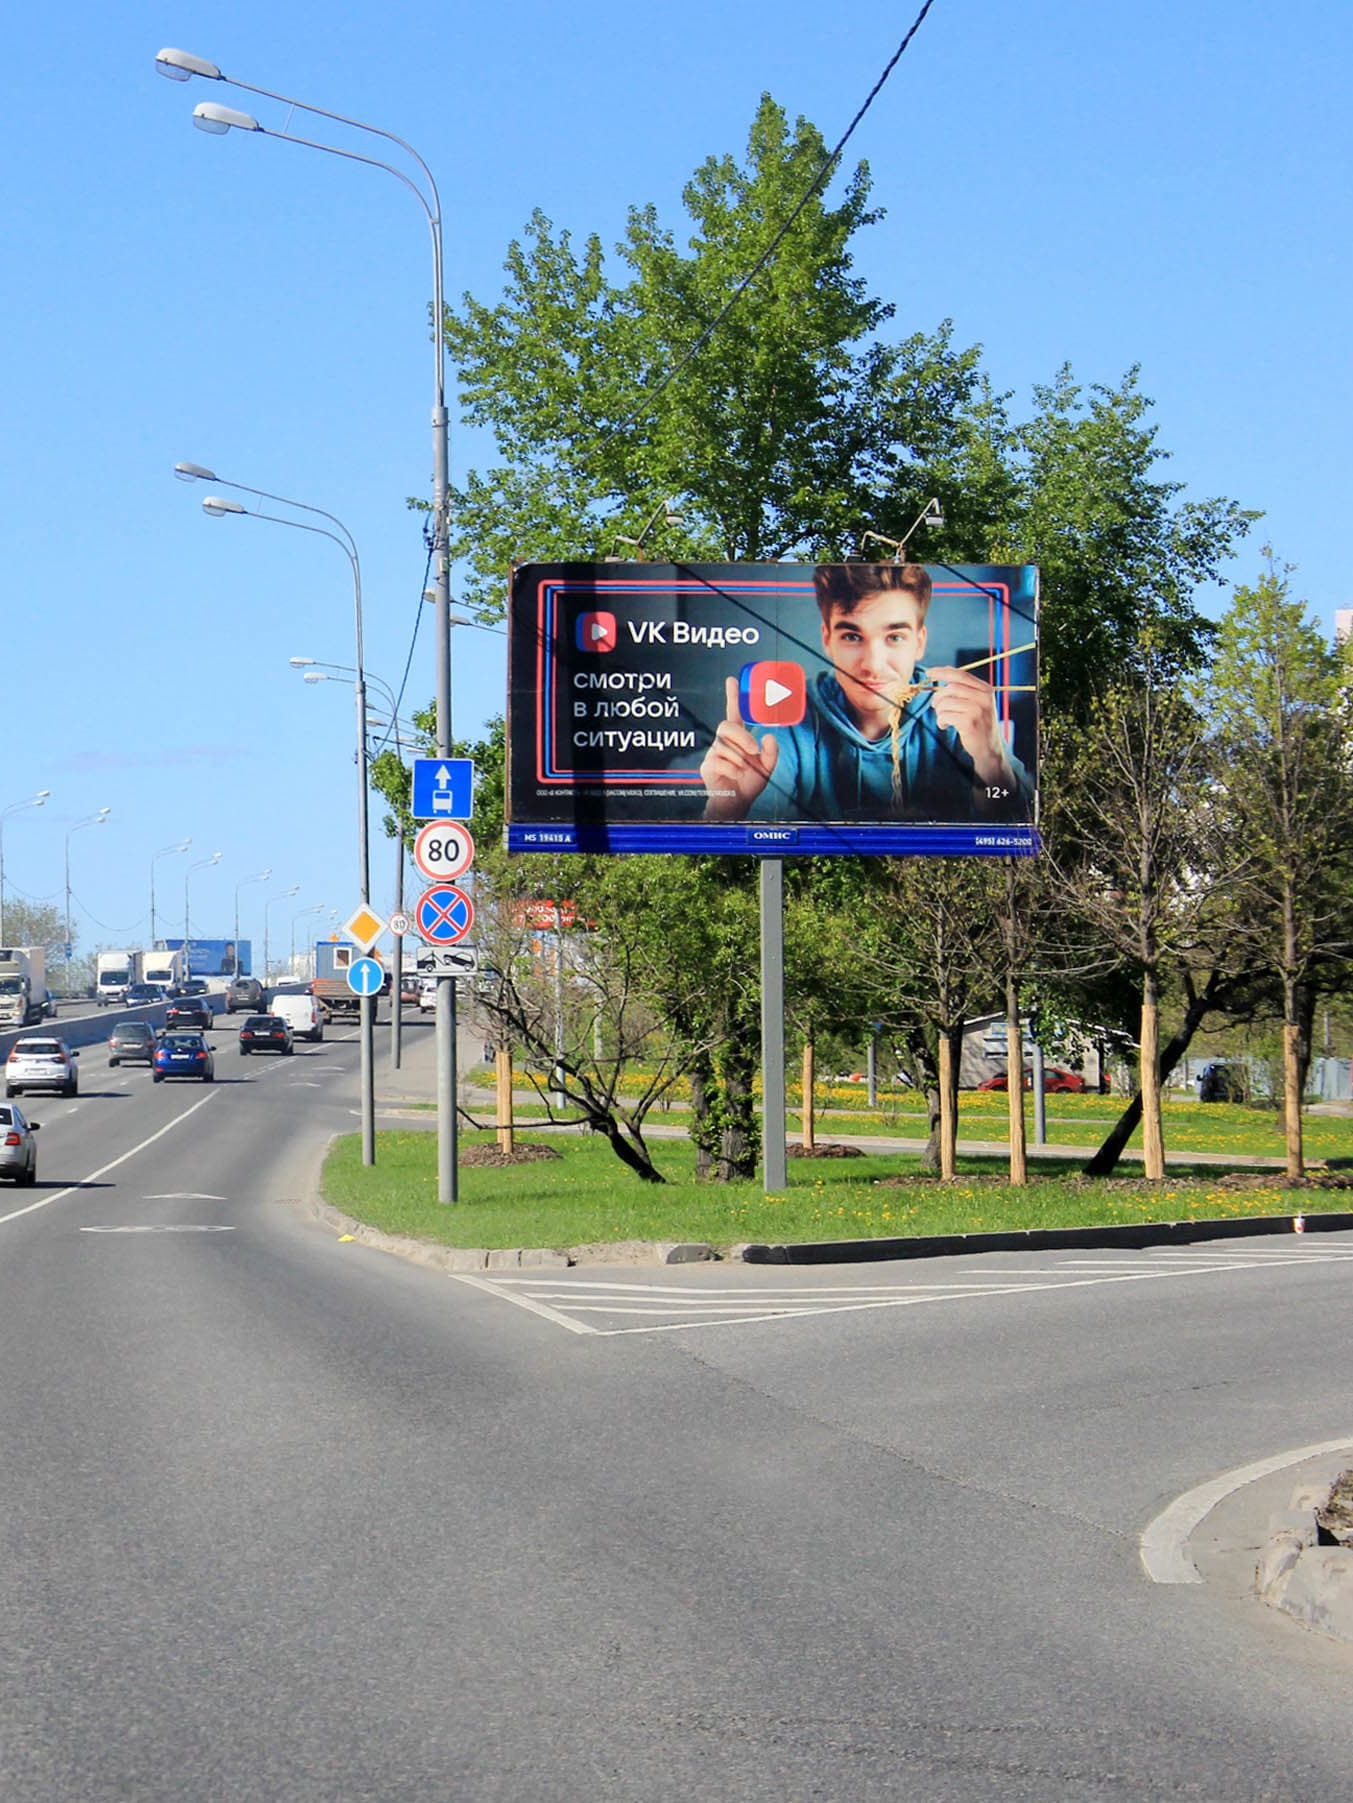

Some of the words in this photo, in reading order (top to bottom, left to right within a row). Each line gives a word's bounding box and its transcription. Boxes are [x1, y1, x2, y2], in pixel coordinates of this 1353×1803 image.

[627, 621, 667, 644] VK
[672, 621, 760, 648] Видео
[573, 672, 672, 693] смотри
[573, 701, 588, 718] в
[593, 696, 680, 718] любой
[573, 730, 696, 753] ситуации
[984, 786, 1009, 799] 12+
[428, 839, 460, 862] 80
